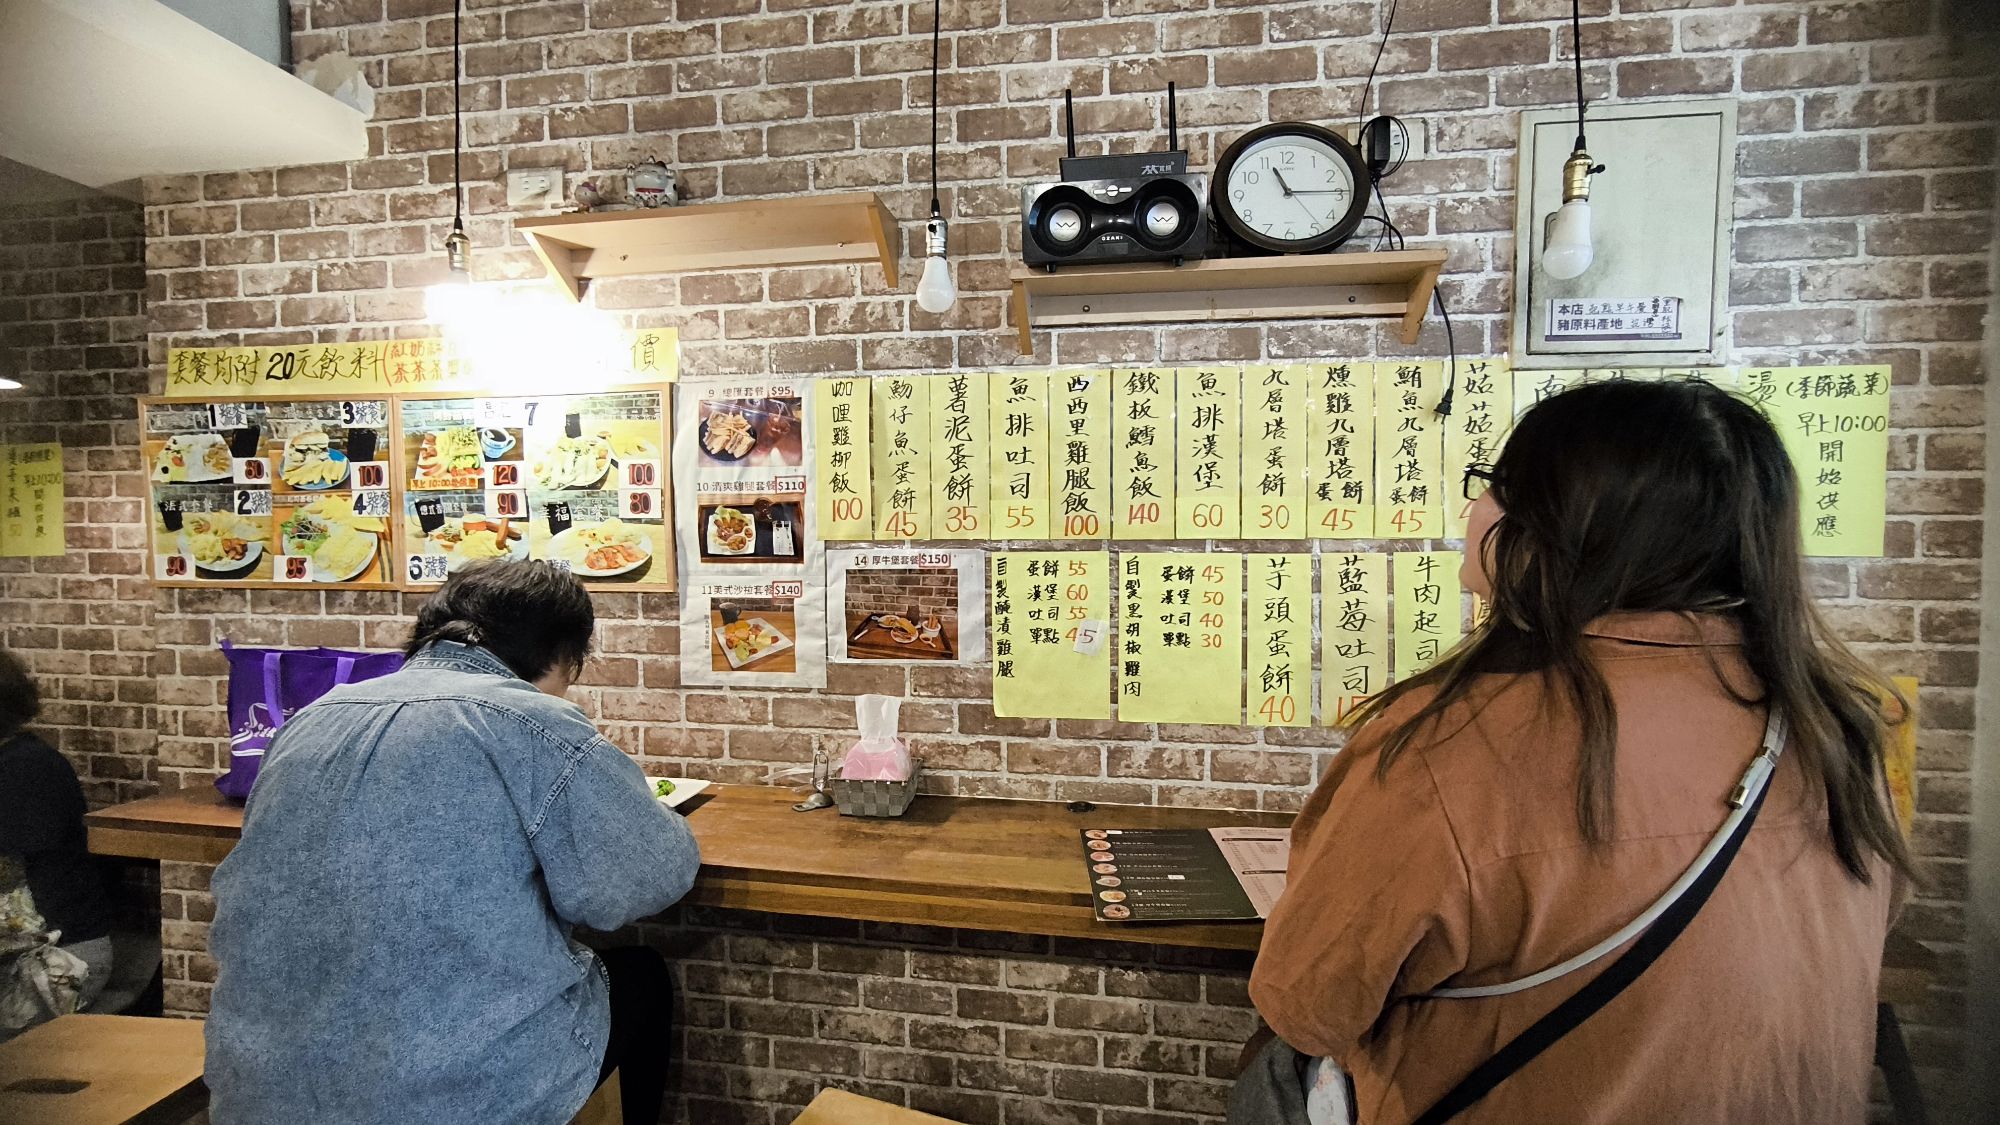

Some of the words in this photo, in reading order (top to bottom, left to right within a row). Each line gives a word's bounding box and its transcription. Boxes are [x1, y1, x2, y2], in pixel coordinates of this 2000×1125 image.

[1261, 156, 1270, 170] 11
[1279, 151, 1295, 165] 12
[1311, 155, 1316, 168] 1
[1242, 171, 1259, 185] 10
[1325, 169, 1336, 183] 2
[1233, 189, 1245, 202] 9
[1334, 187, 1344, 201] 3
[1243, 209, 1253, 222] 8
[1325, 209, 1335, 221] 4
[1262, 223, 1273, 235] 7
[1284, 227, 1296, 241] 6
[1308, 222, 1320, 237] 5
[1558, 303, 1584, 316] 本店
[771, 386, 791, 396] $95
[1191, 372, 1227, 492] 魚排漢堡
[1256, 368, 1290, 498] 九層塔蛋餅
[1797, 411, 1887, 437] 早上10:00
[943, 376, 975, 506] 薯泥蛋餅
[1004, 376, 1037, 500] 魚排吐司
[1061, 374, 1097, 515] 西西里雞腿飯
[1123, 371, 1162, 500] 鐵板鱈魚飯
[358, 464, 383, 487] 100
[492, 463, 519, 486] 120
[628, 463, 655, 486] 100
[777, 482, 804, 491] $110
[1811, 439, 1844, 538] 開始供應
[497, 493, 519, 516] 90
[629, 492, 652, 515] 80
[831, 498, 863, 523] 100
[1128, 502, 1160, 525] 140
[885, 511, 918, 537] 45
[945, 505, 979, 532] 35
[1006, 505, 1035, 529] 55
[1064, 514, 1099, 536] 100
[1192, 503, 1223, 528] 60
[1258, 504, 1290, 530] 30
[1321, 508, 1357, 532] 45
[1390, 509, 1426, 532] 45
[166, 556, 188, 576] 90
[285, 556, 307, 579] 95
[920, 553, 949, 565] $150
[1026, 559, 1060, 579] 蛋餅
[1068, 559, 1088, 577] 55
[1160, 564, 1195, 585] 蛋餅
[1201, 564, 1225, 584] 45
[775, 584, 800, 597] $140
[1026, 583, 1060, 602] 漢堡
[1066, 583, 1089, 601] 60
[1160, 588, 1192, 606] 漢堡
[1202, 590, 1225, 606] 50
[1028, 606, 1060, 622] 吐司
[1065, 606, 1088, 621] 55
[1160, 611, 1192, 628] 吐司
[1199, 611, 1224, 628] 40
[1333, 553, 1377, 696] 藍莓吐司
[1410, 555, 1441, 678] 牛肉起司
[1029, 627, 1060, 645] 單點
[1259, 556, 1295, 696] 芋頭蛋餅
[1162, 631, 1192, 649] 單點
[1201, 632, 1223, 649] 30
[1258, 694, 1296, 724] 40
